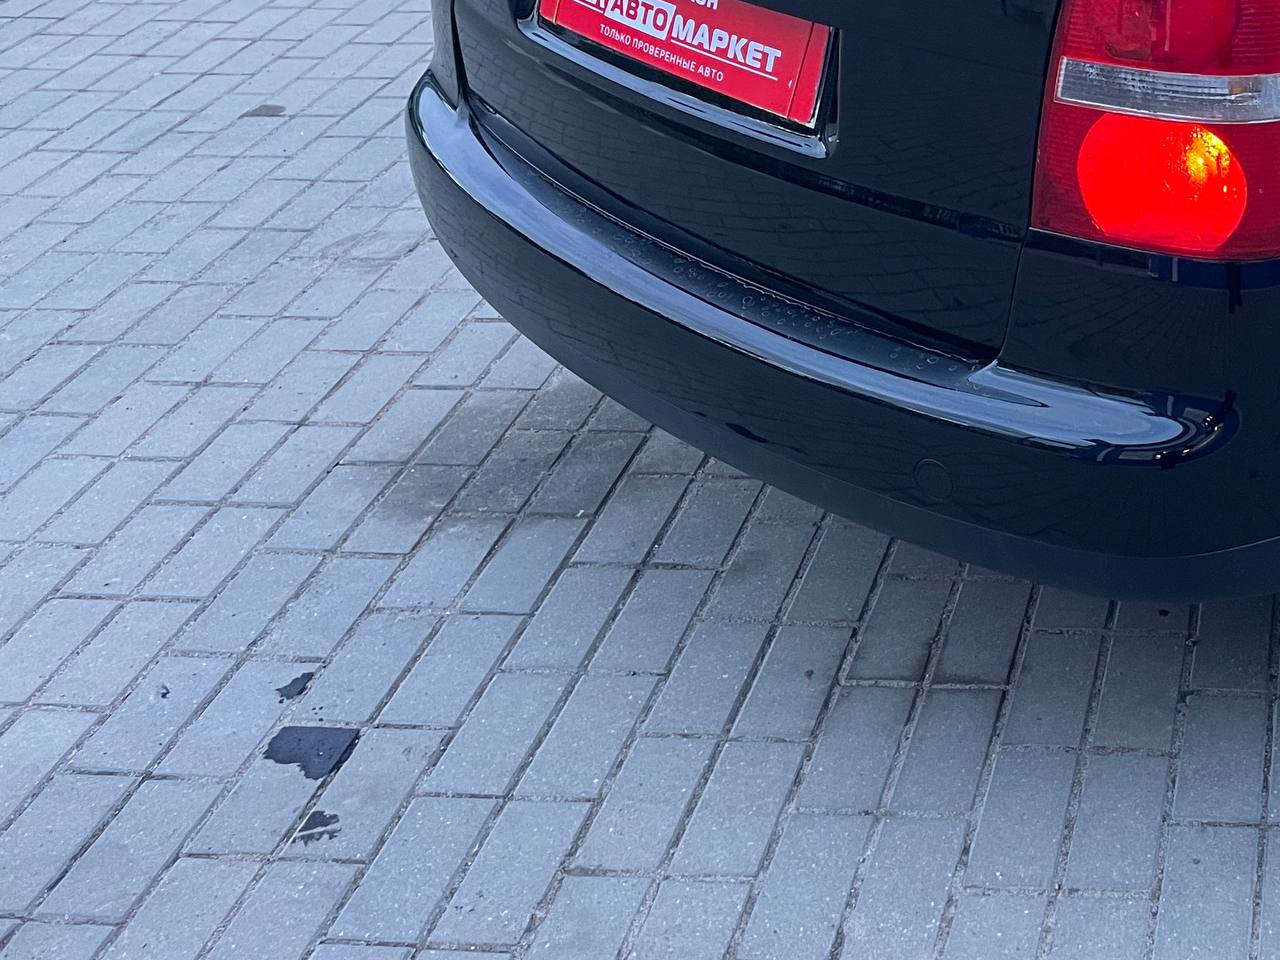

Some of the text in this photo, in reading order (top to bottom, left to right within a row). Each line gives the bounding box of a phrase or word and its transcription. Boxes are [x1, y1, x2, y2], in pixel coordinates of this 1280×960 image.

[599, 23, 724, 82] ТОЛЬКО ПРОВЕРЕННЫЕ АВТО
